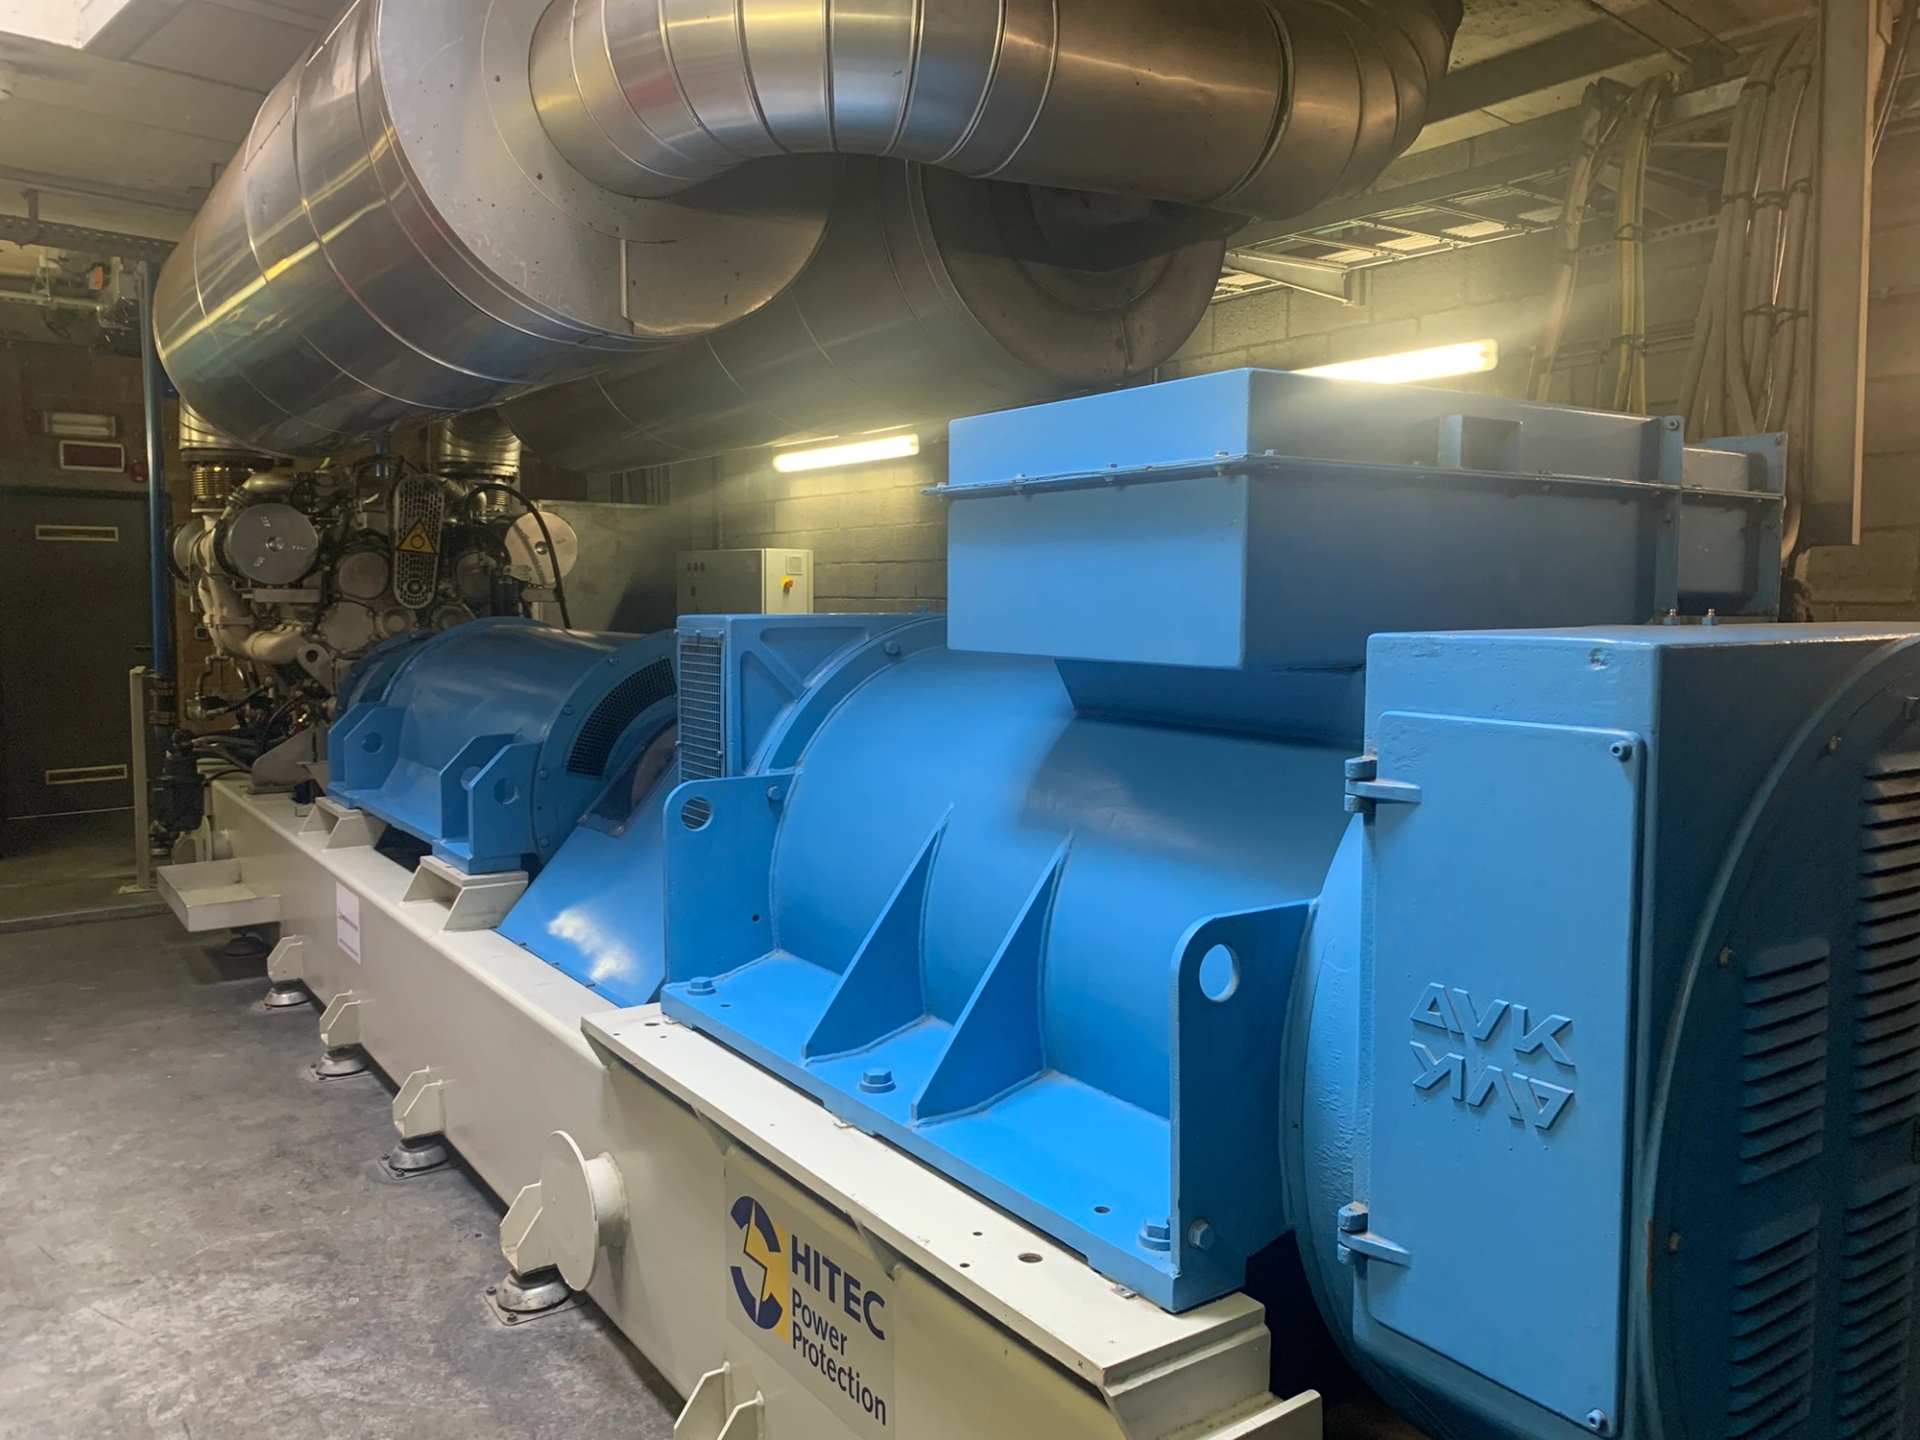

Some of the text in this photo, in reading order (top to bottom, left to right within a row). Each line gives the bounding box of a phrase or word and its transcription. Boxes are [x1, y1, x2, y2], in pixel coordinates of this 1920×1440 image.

[1410, 982, 1575, 1067] AVK
[791, 1234, 886, 1341] HITEC
[792, 1287, 848, 1356] Power
[792, 1320, 887, 1427] Protection
